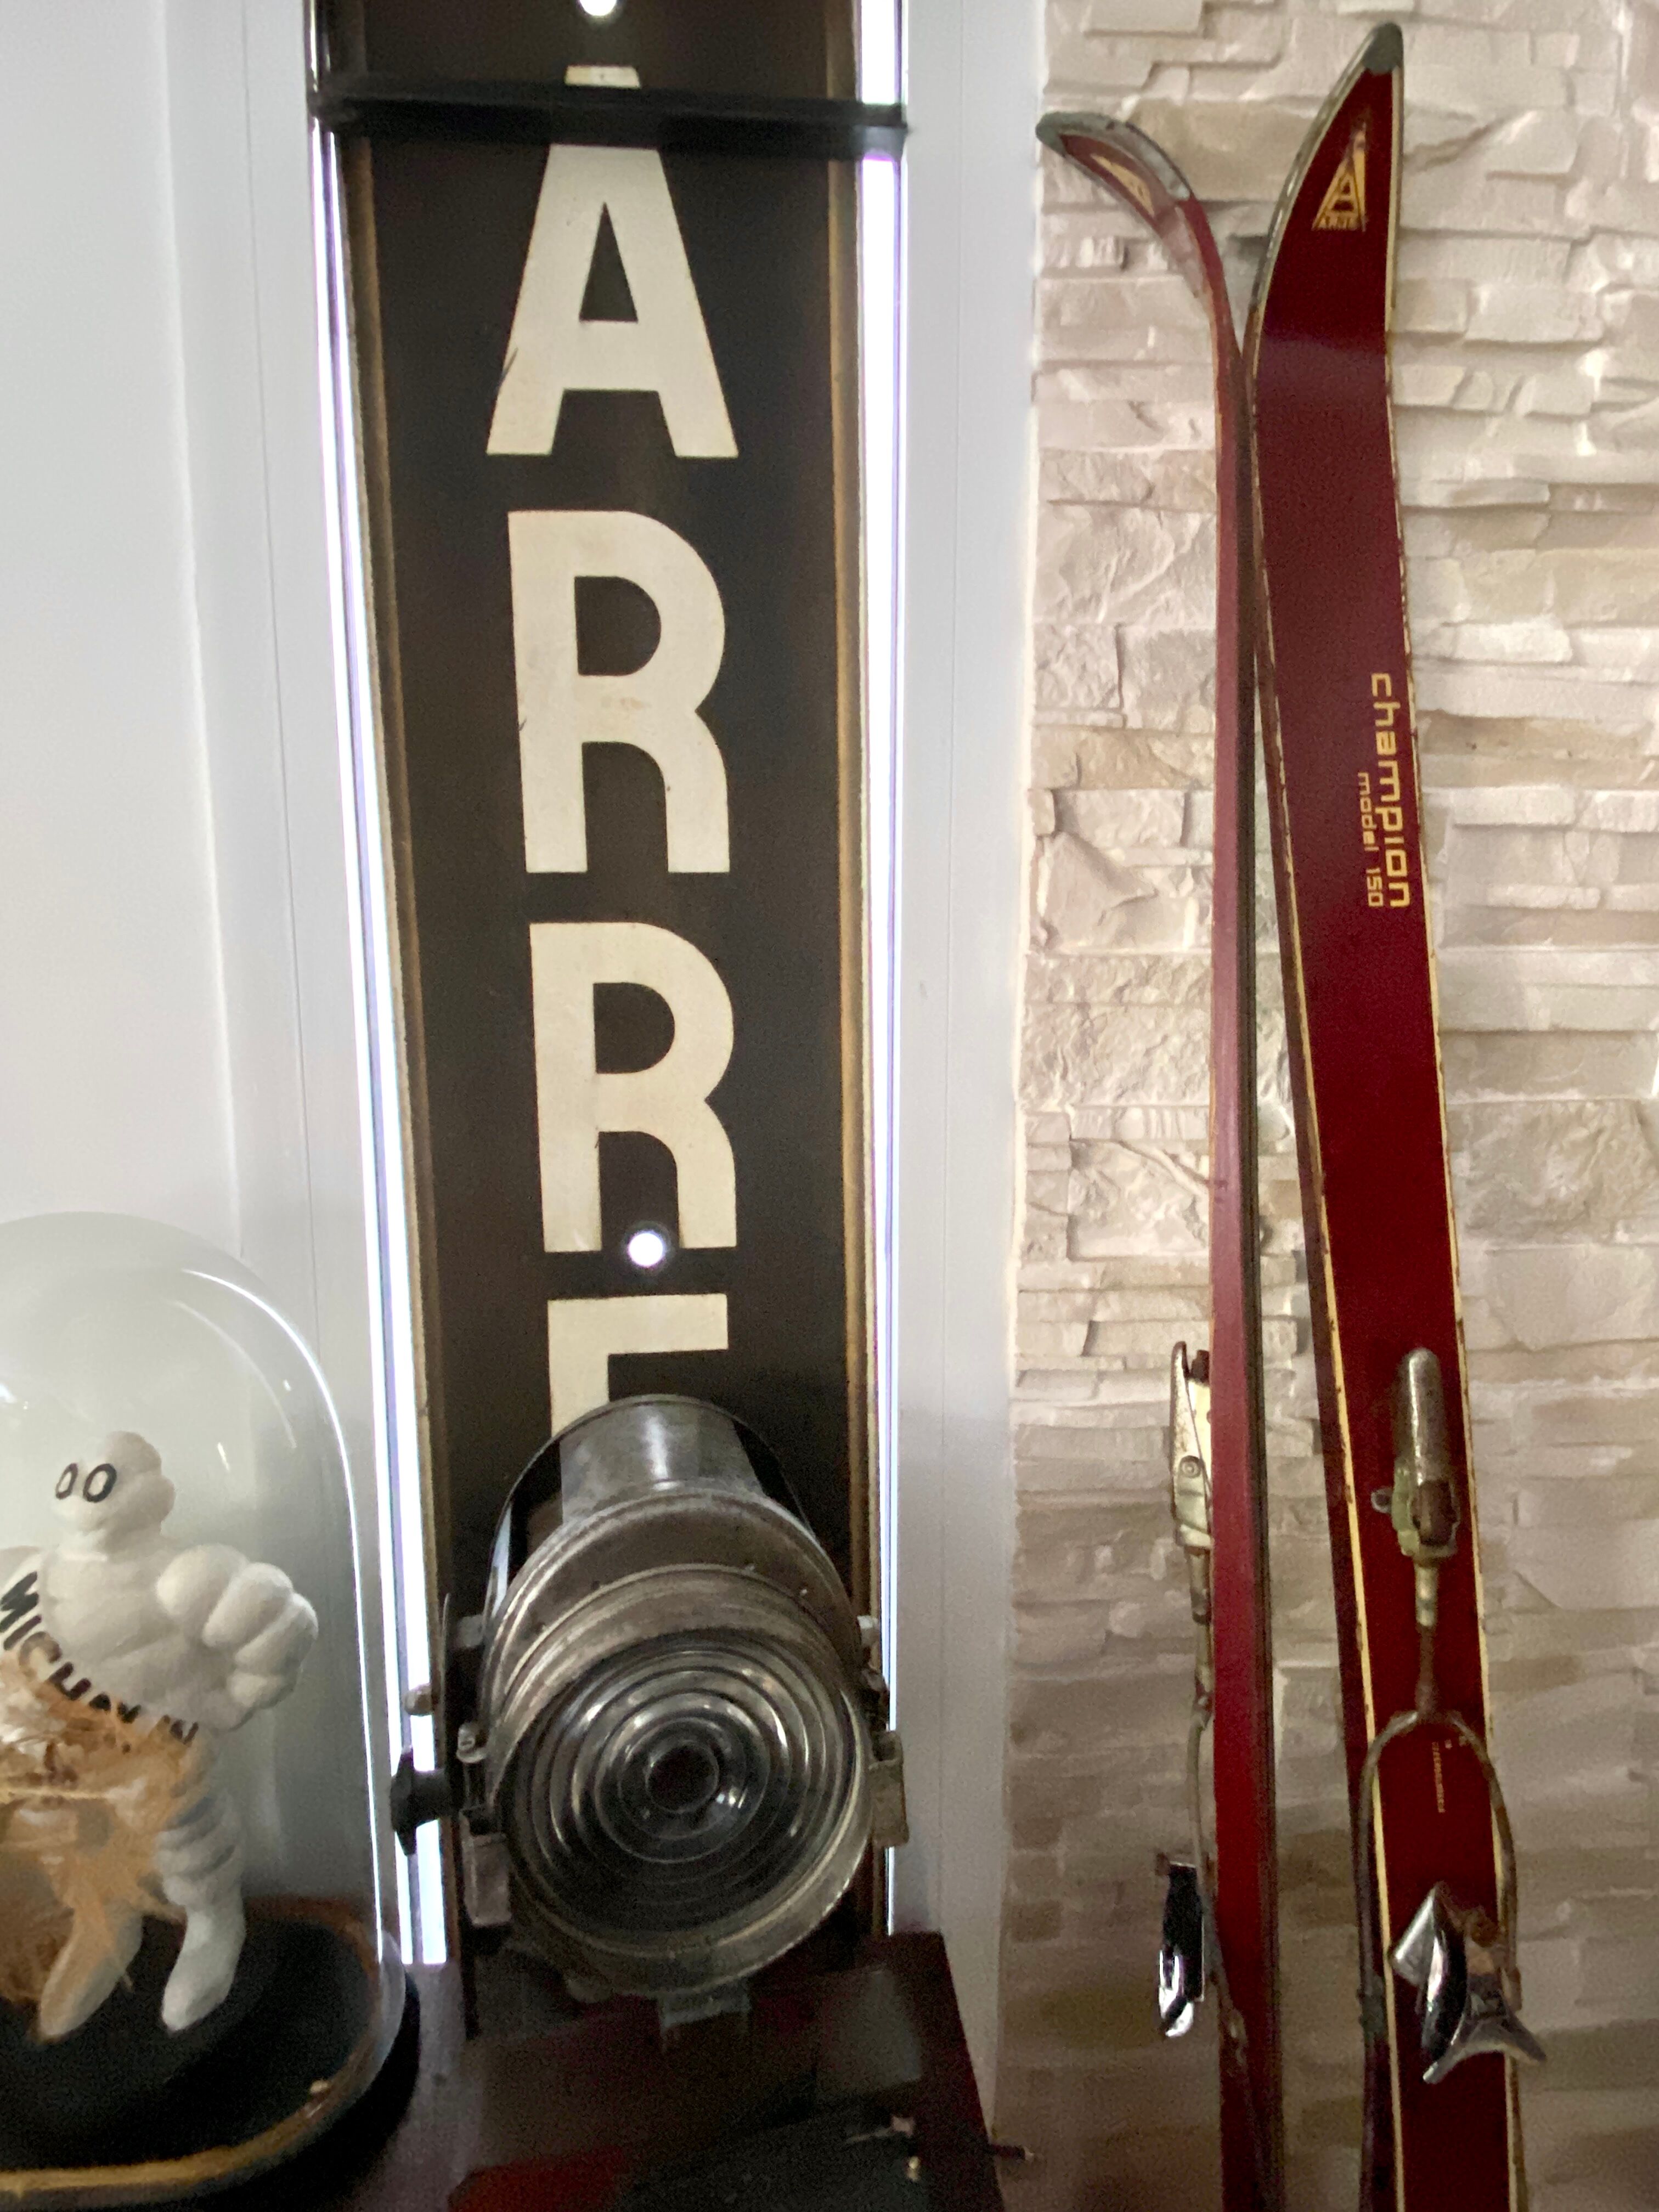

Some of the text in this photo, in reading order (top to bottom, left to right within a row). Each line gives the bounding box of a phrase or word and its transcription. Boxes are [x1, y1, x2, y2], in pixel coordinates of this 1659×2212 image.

[1358, 772, 1384, 908] model 150
[1371, 673, 1410, 908] champion
